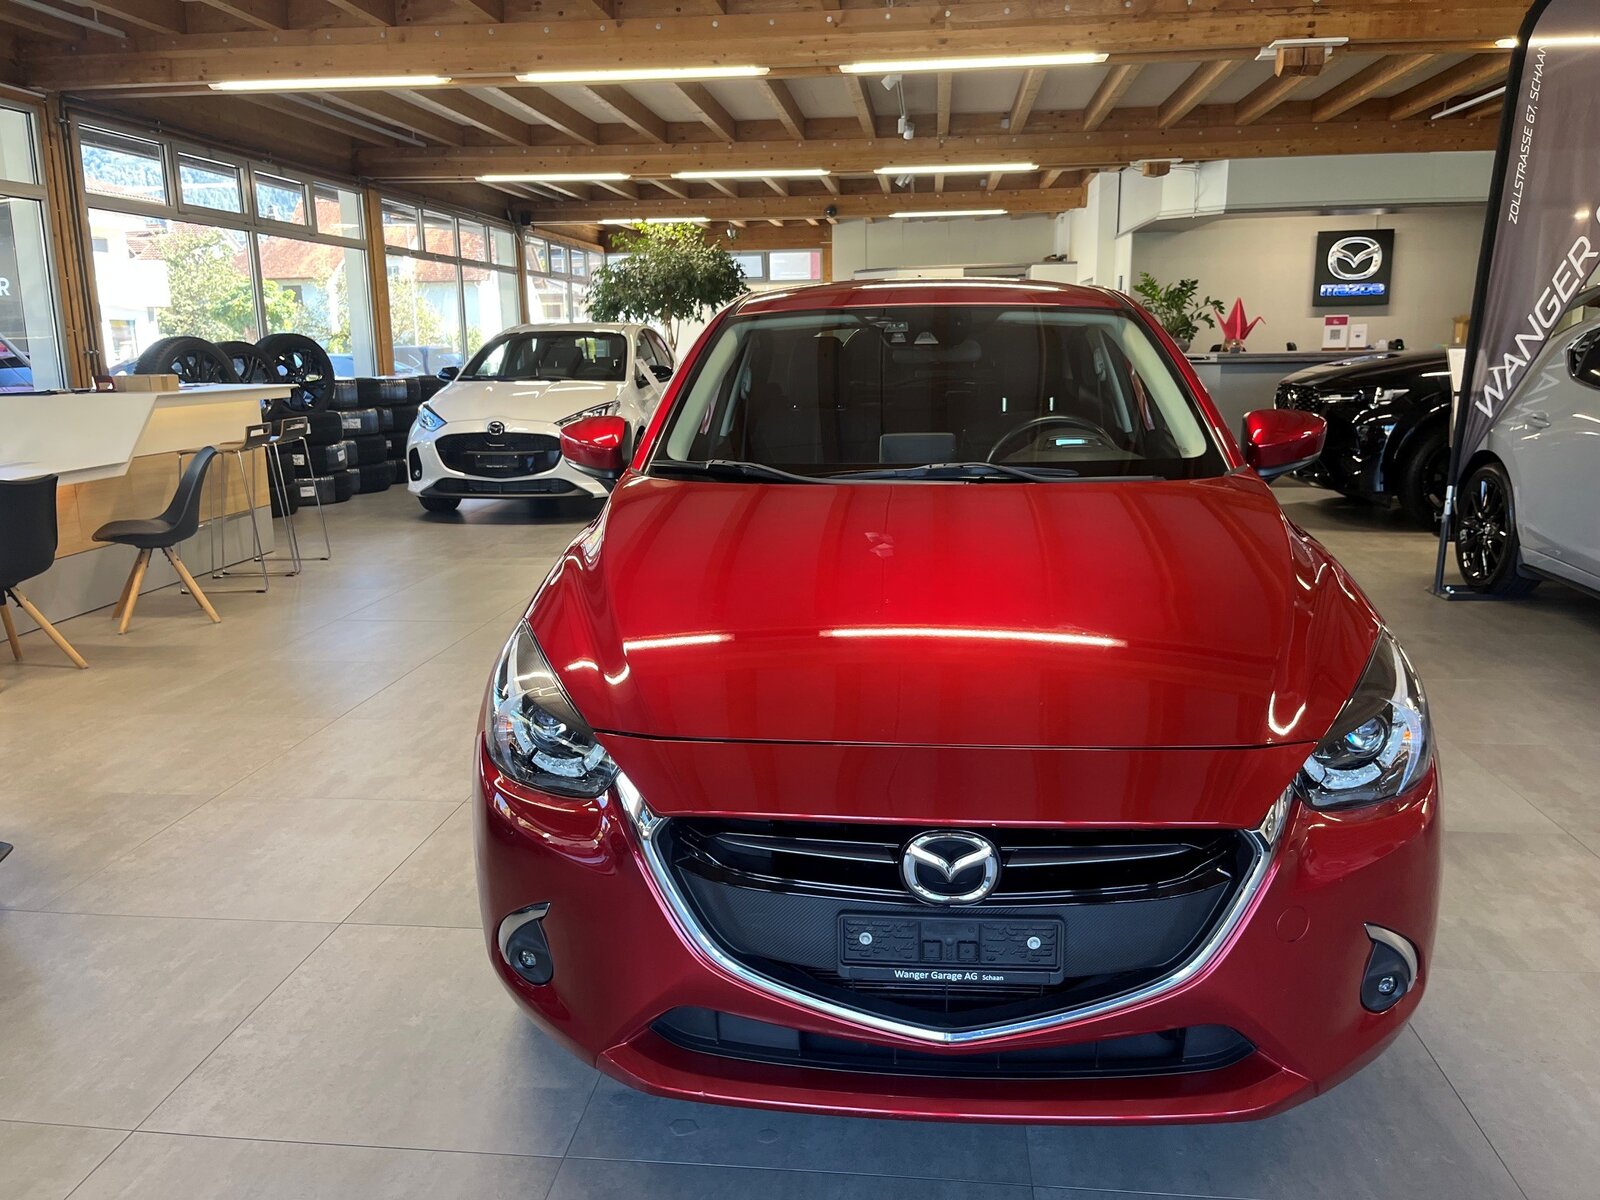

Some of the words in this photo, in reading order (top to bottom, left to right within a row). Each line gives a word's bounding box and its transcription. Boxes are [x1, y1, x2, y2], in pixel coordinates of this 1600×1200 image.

[1508, 125, 1533, 224] ZOLLSTRASSE
[1525, 104, 1538, 124] 67,
[1320, 283, 1385, 296] mazda
[1475, 235, 1599, 419] WANGER
[894, 970, 929, 980] Wanger
[930, 971, 963, 981] Garage
[964, 971, 978, 981] AG
[982, 973, 1004, 981] Schaan
